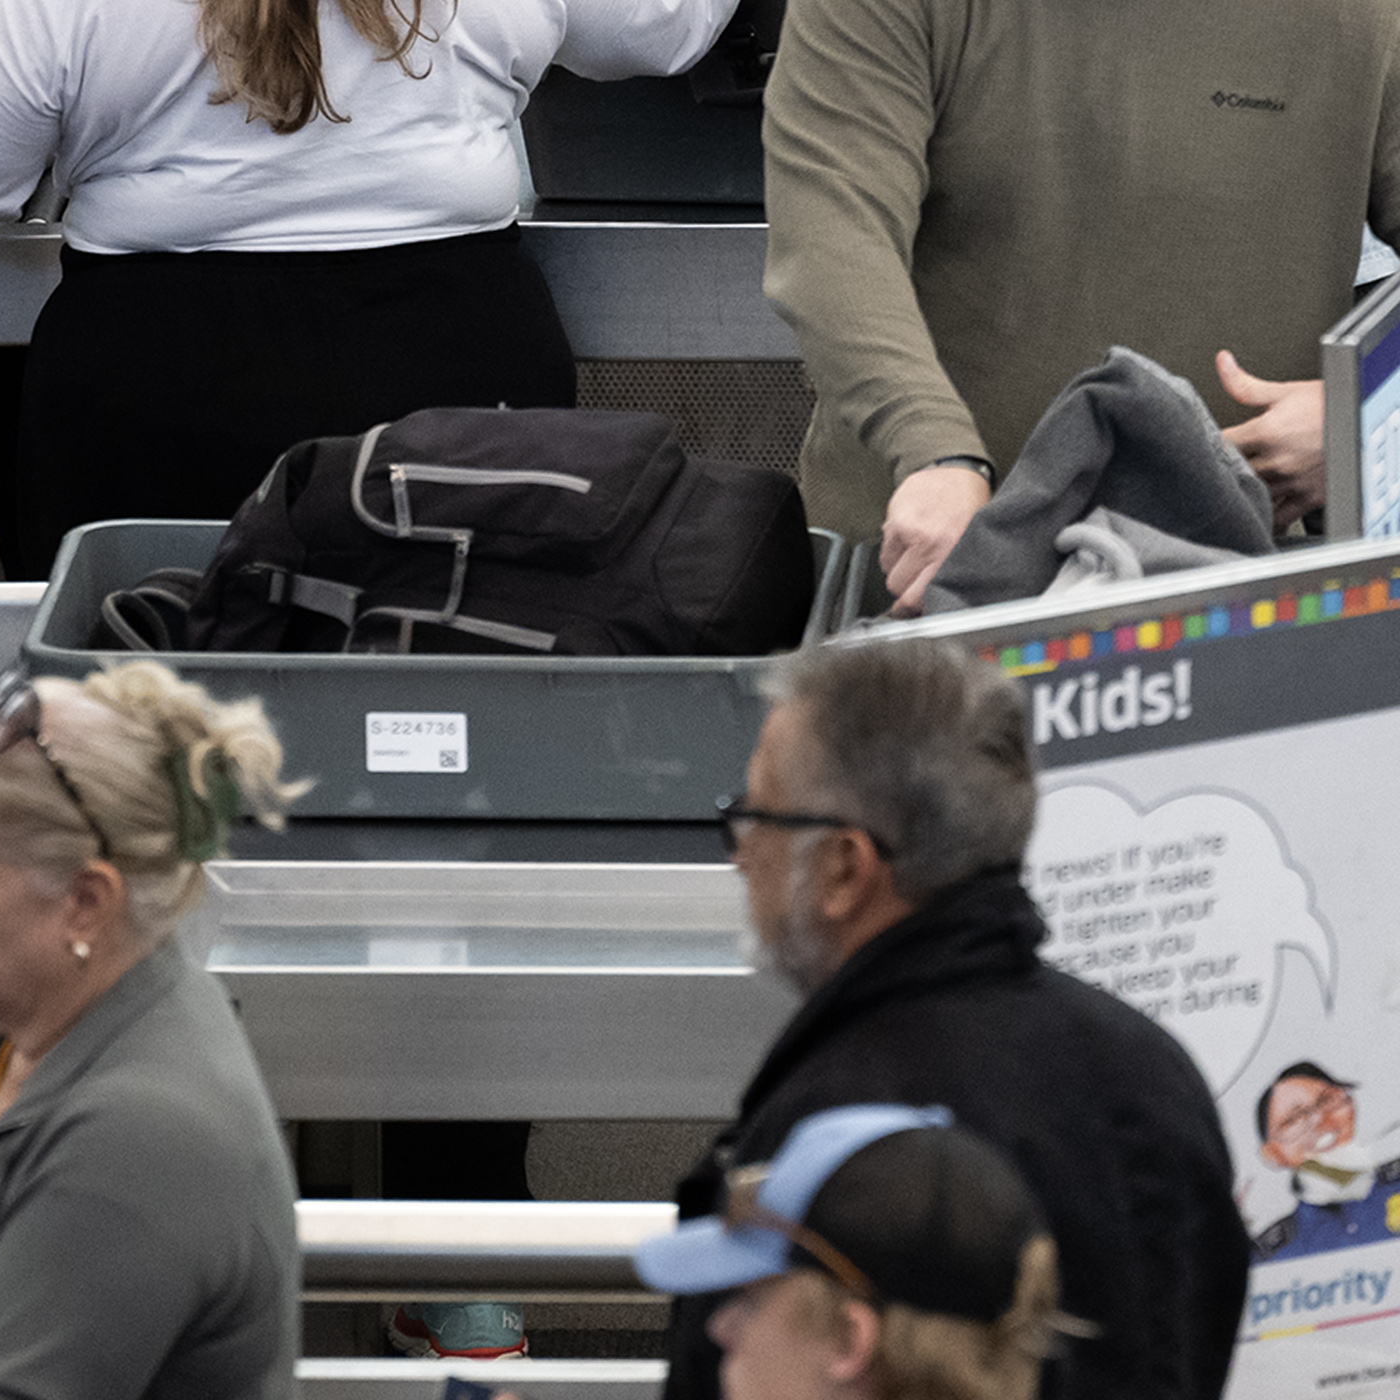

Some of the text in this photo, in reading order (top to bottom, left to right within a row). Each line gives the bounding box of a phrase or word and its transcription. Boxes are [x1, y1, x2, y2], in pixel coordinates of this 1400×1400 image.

[1033, 658, 1193, 744] Kids!
[370, 720, 458, 736] S-224736
[1062, 882, 1138, 913] under
[1145, 867, 1214, 895] make
[1062, 900, 1218, 945] tighten your
[1147, 932, 1196, 962] you
[1112, 953, 1241, 994] keep your
[1177, 981, 1262, 1015] during
[1251, 1267, 1393, 1325] priority
